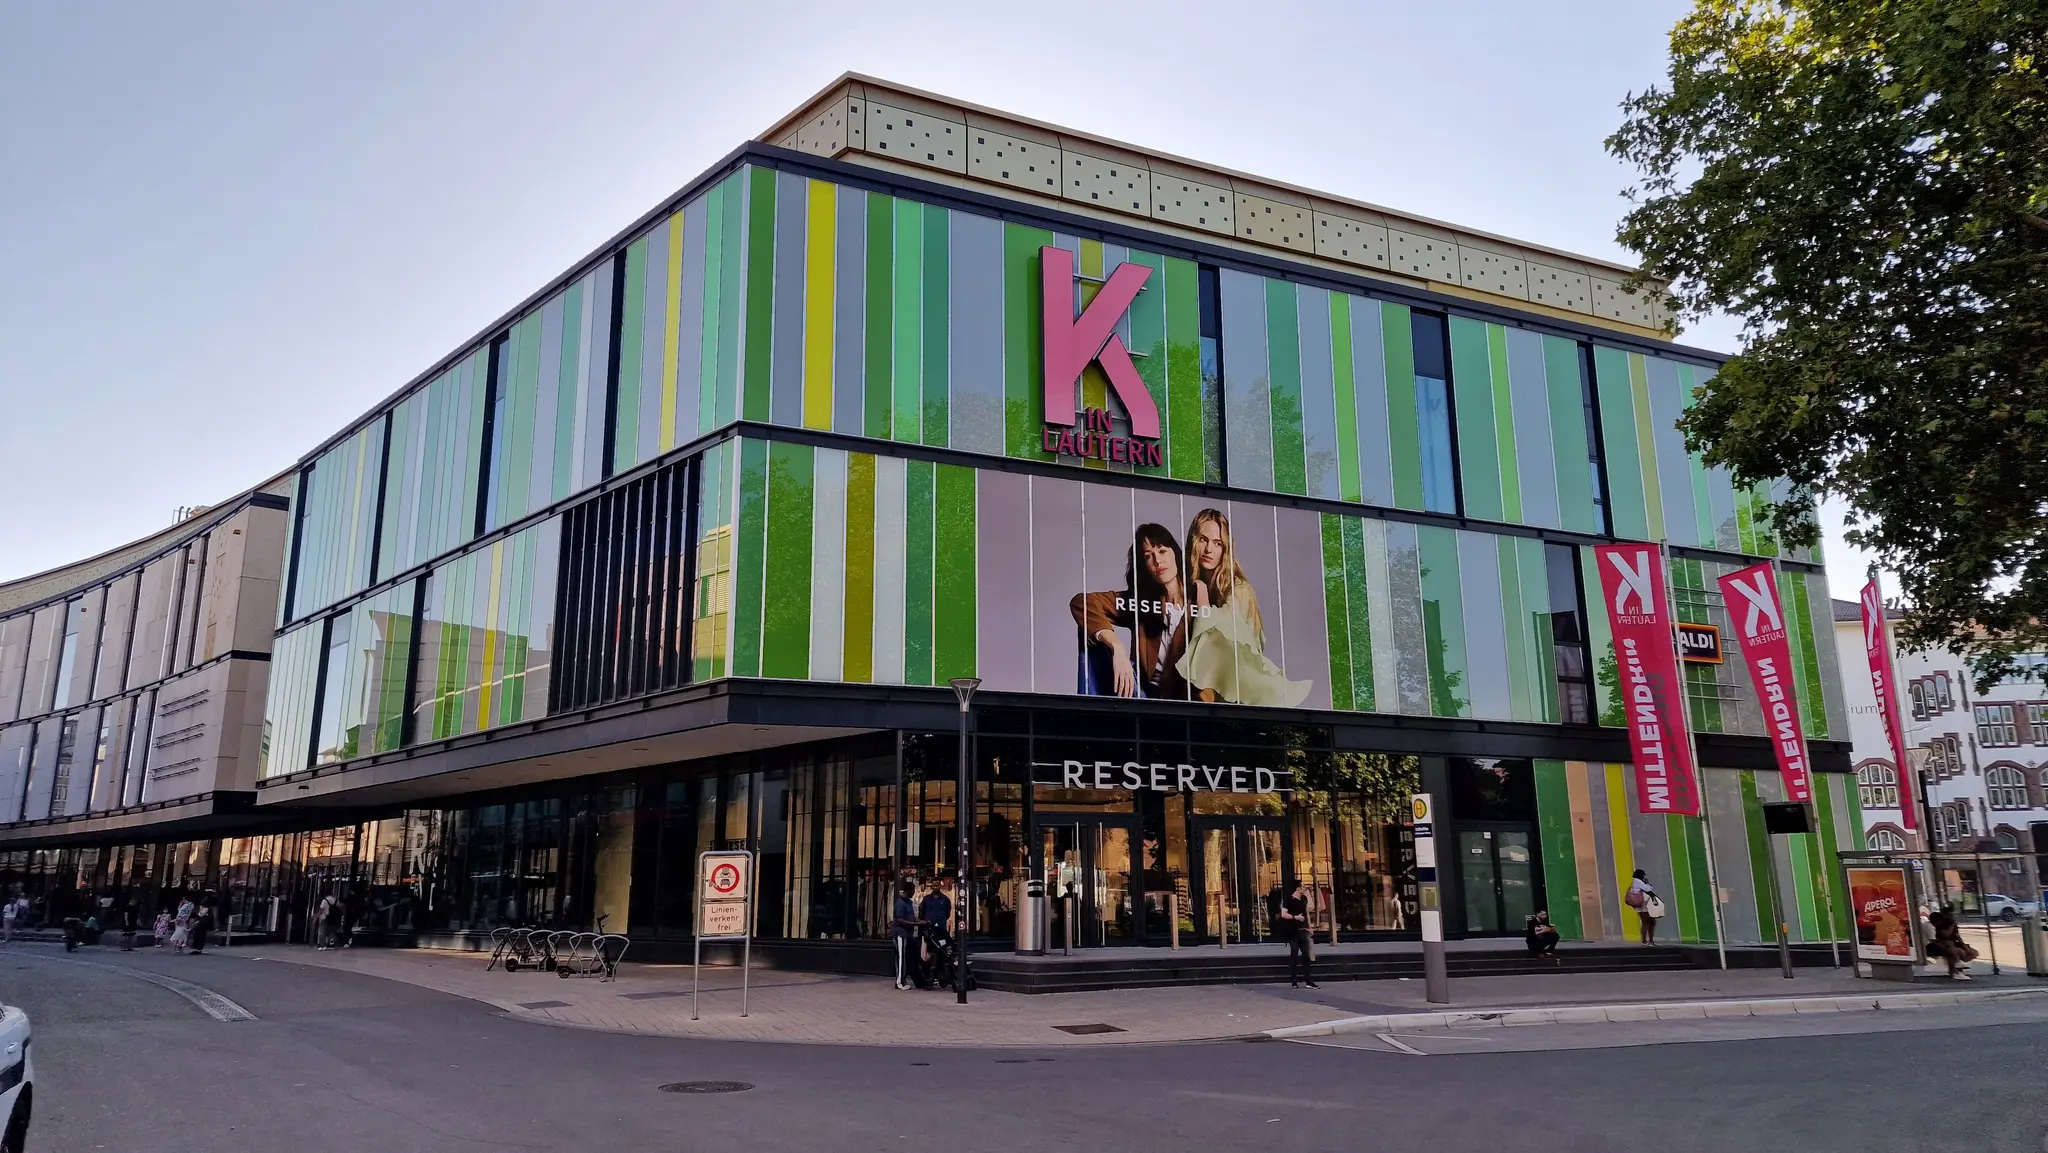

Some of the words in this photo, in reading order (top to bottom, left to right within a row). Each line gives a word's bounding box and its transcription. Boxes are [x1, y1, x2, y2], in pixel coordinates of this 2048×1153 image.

[1040, 246, 1160, 440] K
[1085, 407, 1113, 433] IN
[1042, 427, 1163, 467] LAUTERN
[1115, 597, 1211, 618] RESERVED
[1679, 632, 1714, 649] ALDI
[1847, 703, 1878, 715] ium
[1063, 760, 1275, 794] RESERVED
[711, 906, 738, 914] Linien-
[1864, 897, 1897, 913] APEROL
